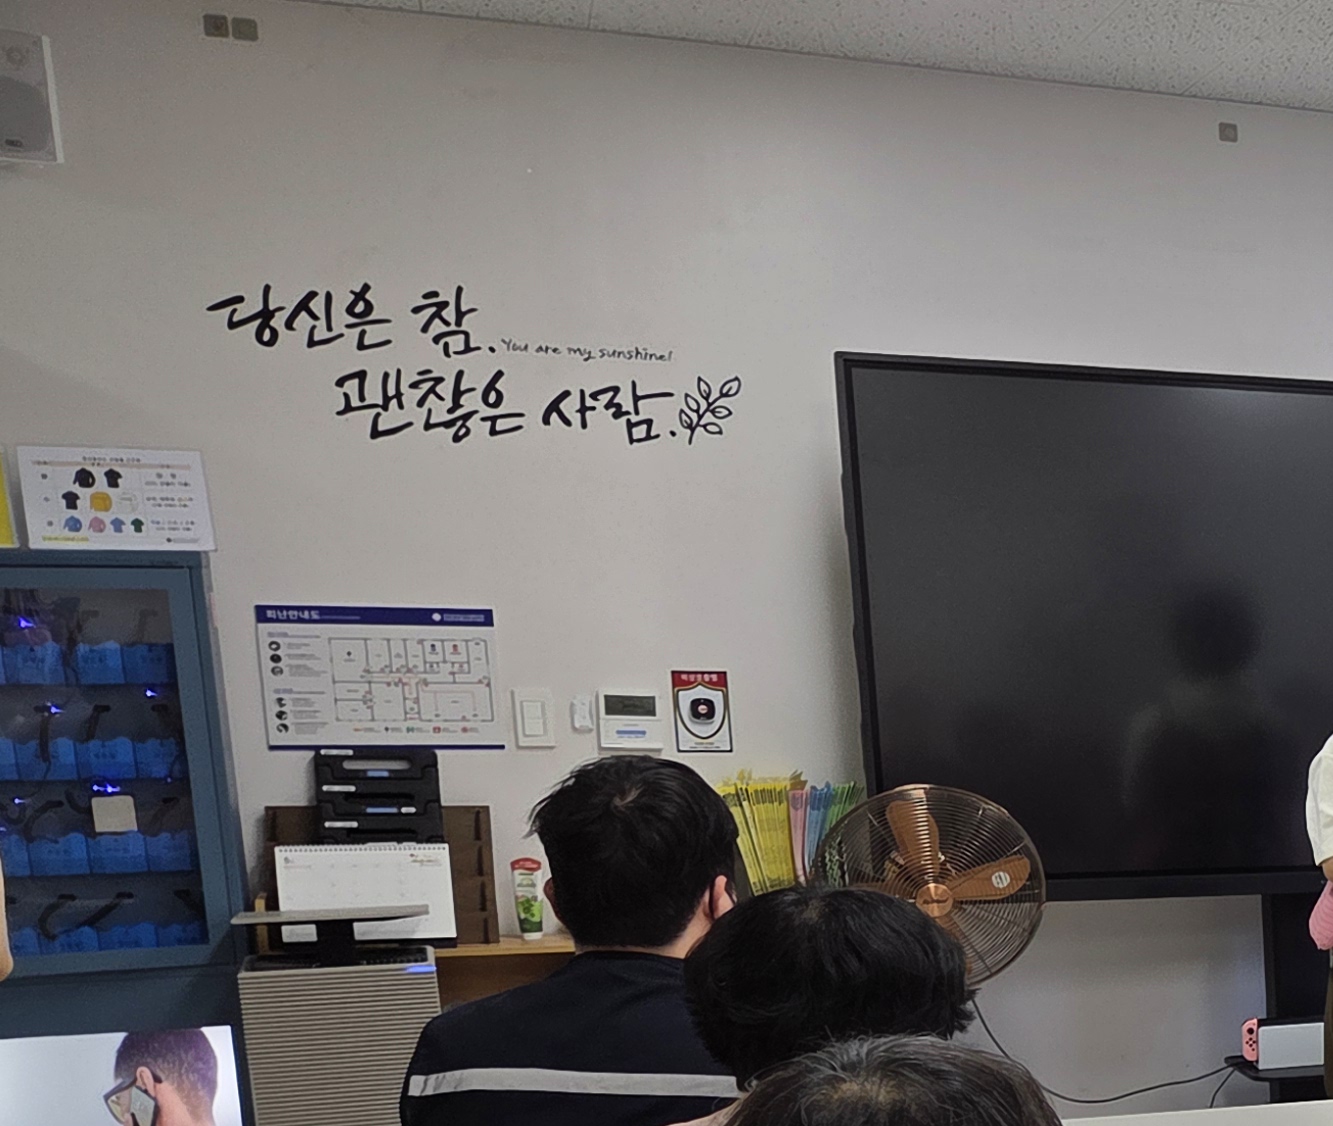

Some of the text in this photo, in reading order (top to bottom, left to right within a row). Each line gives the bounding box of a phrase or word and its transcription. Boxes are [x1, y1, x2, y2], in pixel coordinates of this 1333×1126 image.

[206, 283, 392, 351] 당신은
[501, 338, 529, 353] You
[535, 344, 562, 356] are
[567, 347, 596, 362] my
[335, 368, 526, 443] 괜찮은
[266, 609, 320, 620] 피난안내도
